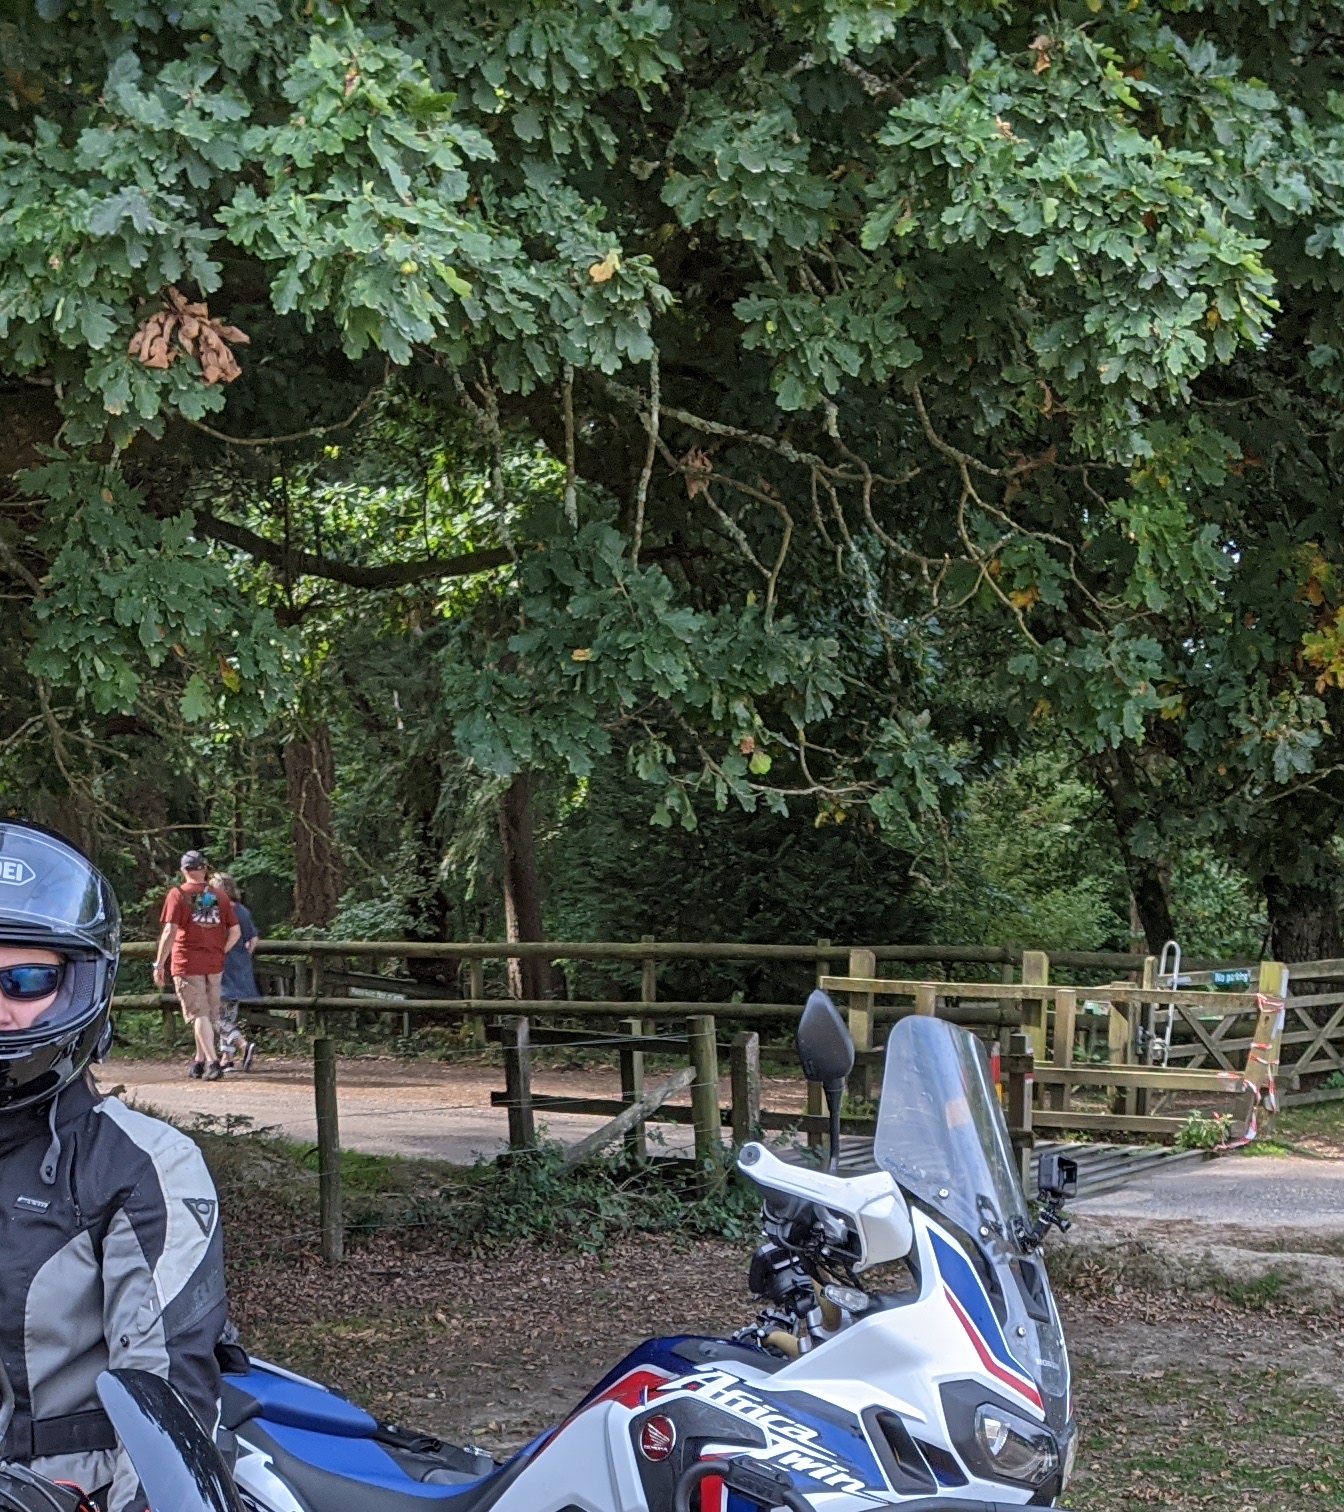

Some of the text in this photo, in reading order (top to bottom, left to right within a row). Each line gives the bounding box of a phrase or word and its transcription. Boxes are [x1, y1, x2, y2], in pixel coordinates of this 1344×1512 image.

[1214, 972, 1224, 982] No
[657, 1367, 828, 1449] Africa
[750, 1428, 882, 1500] Twin
